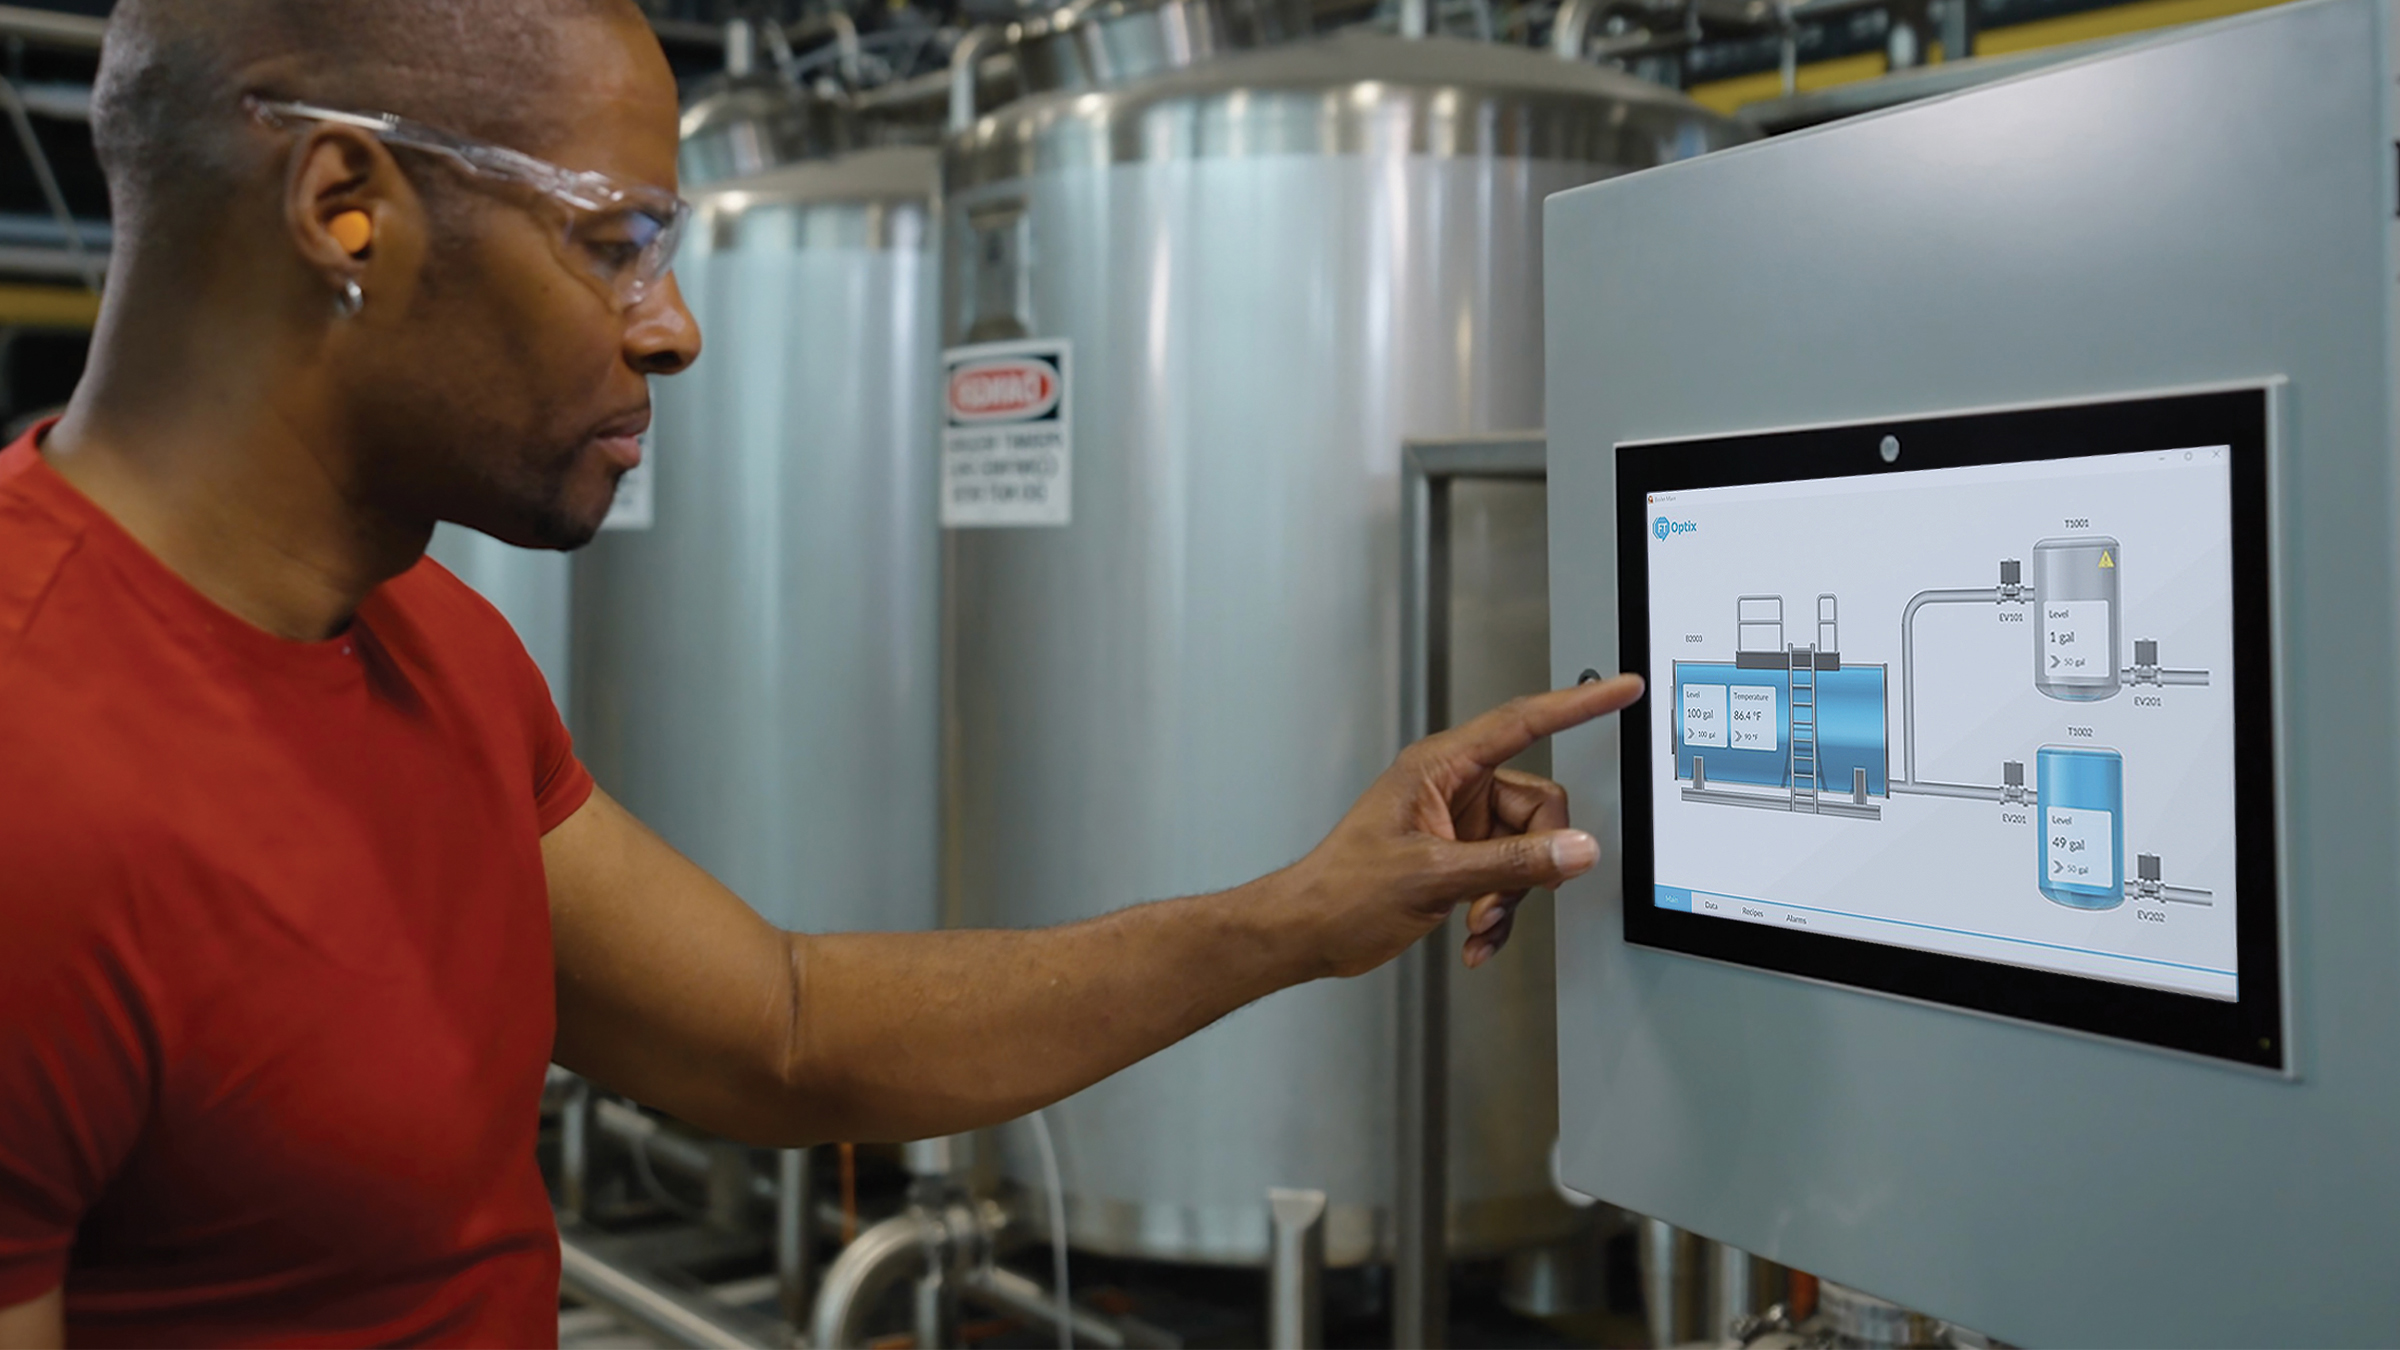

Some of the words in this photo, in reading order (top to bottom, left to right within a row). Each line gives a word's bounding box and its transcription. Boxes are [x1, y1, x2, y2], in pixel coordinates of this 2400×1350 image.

[1671, 520, 1697, 535] Optix
[2064, 519, 2089, 528] T1001
[1999, 612, 2023, 622] EV101
[2049, 610, 2069, 619] Level
[2050, 631, 2056, 643] 1
[2059, 631, 2075, 645] gal
[2064, 658, 2073, 666] 50
[2075, 657, 2085, 668] gal
[1733, 692, 1769, 702] Temperature
[2134, 697, 2162, 707] EV201
[1687, 708, 1701, 718] 100
[1703, 709, 1714, 720] gal
[1733, 710, 1751, 720] 86.4
[2068, 727, 2093, 737] T1002
[2003, 814, 2026, 824] EV201
[2052, 815, 2072, 825] Level
[2052, 837, 2067, 849] 49
[2069, 839, 2085, 852] gal
[2067, 864, 2077, 873] 50
[2079, 866, 2089, 876] gal
[1705, 901, 1718, 910] Data
[1742, 907, 1764, 918] Recipes
[2137, 910, 2166, 922] EV202
[1786, 914, 1807, 925] Alarms
